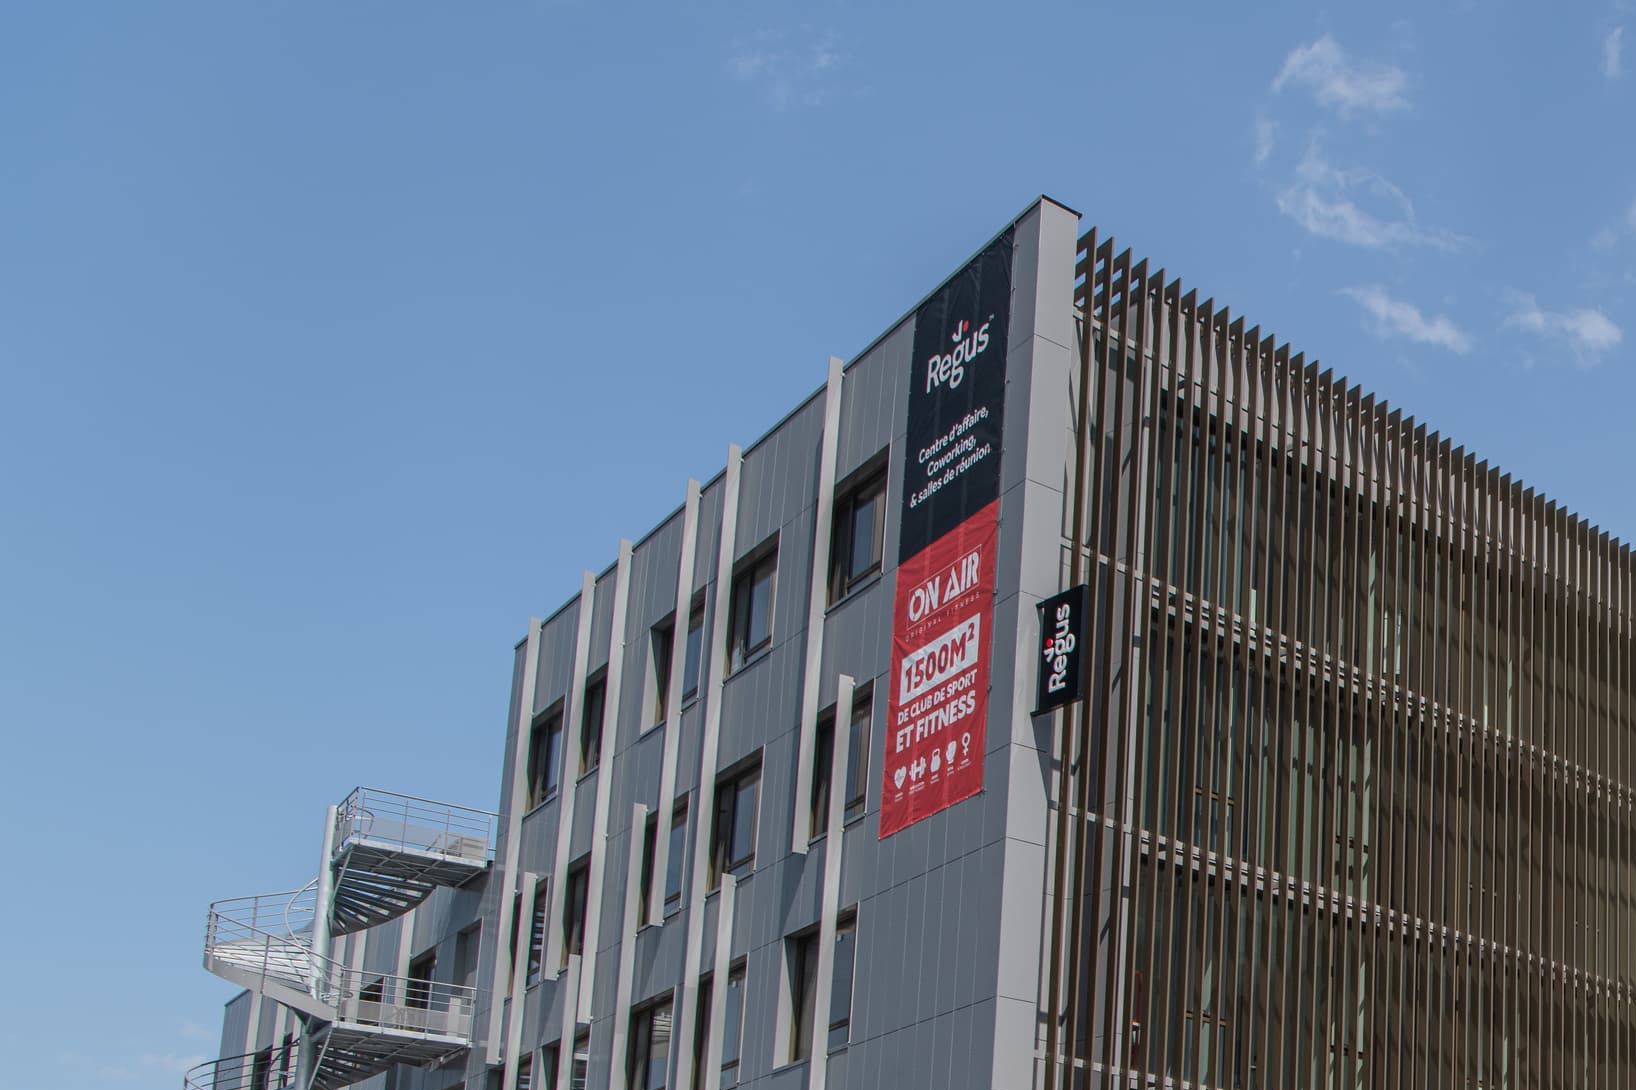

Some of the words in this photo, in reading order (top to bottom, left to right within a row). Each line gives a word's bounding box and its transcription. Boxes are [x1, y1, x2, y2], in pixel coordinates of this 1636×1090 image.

[926, 321, 990, 394] Regus
[919, 434, 948, 463] Centre
[949, 406, 989, 441] d'affaire,
[927, 435, 977, 477] Coworking,
[910, 493, 918, 508] &
[918, 478, 942, 503] salles
[943, 468, 955, 485] de
[909, 576, 940, 622] ON
[943, 551, 979, 604] AIR
[1048, 603, 1076, 693] Regus
[896, 724, 914, 753] ET
[916, 690, 976, 743] FITNESS
[897, 709, 909, 726] DE
[910, 695, 932, 718] CLUB
[934, 687, 945, 705] DE
[947, 669, 978, 696] SPORT
